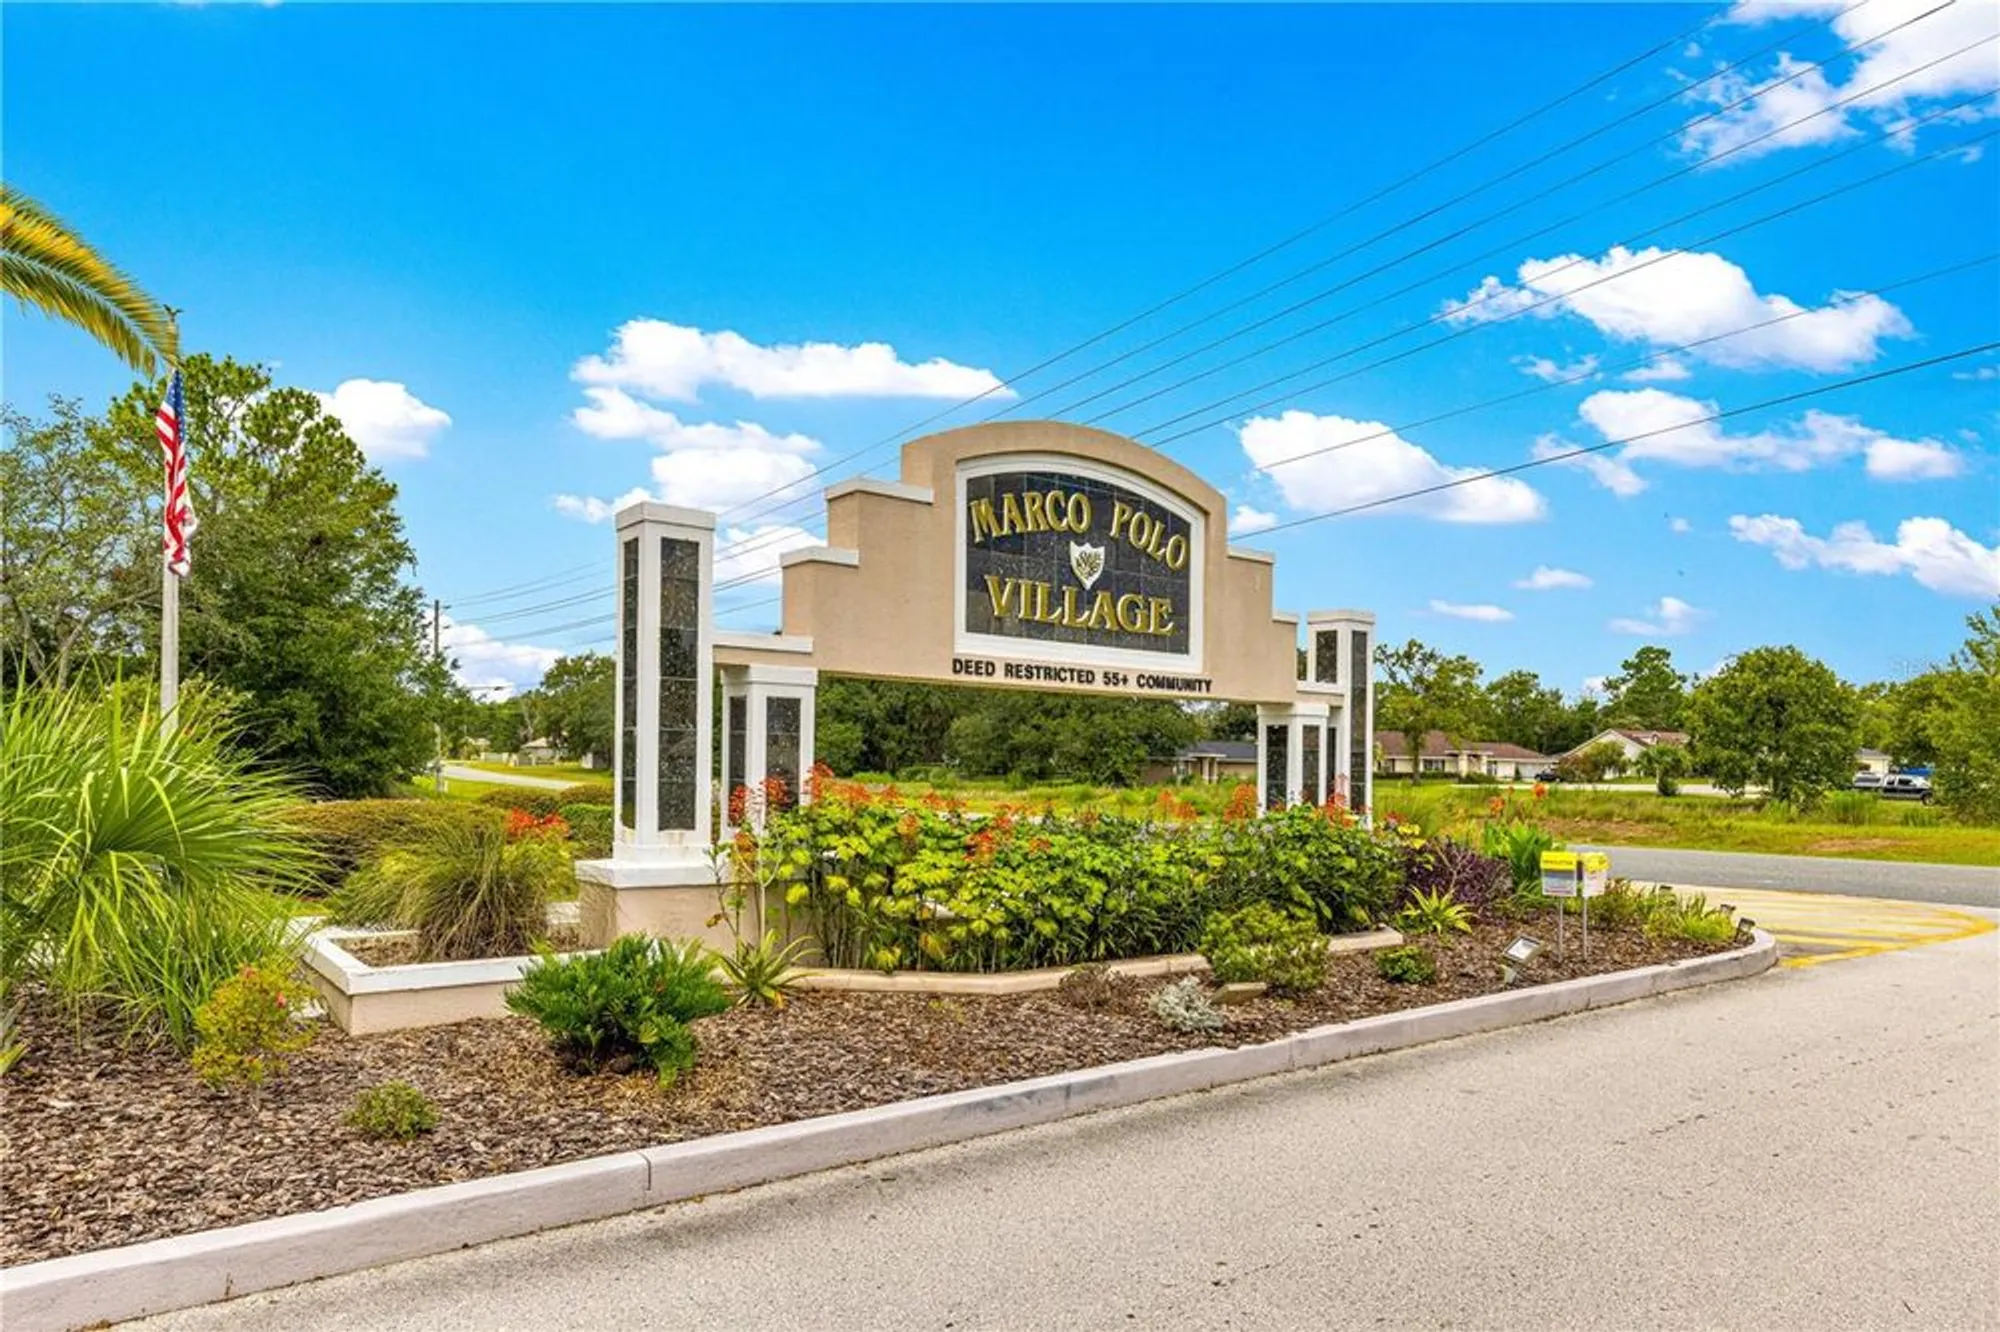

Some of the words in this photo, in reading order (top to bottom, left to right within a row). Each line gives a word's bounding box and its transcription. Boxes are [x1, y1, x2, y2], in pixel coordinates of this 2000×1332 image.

[970, 490, 1092, 543] MARCO
[1109, 499, 1188, 571] POLO
[984, 574, 1175, 636] VILLAGE
[952, 658, 996, 677] DEED
[1004, 663, 1096, 684] RESTRICTED
[1103, 671, 1129, 686] 55+
[1136, 674, 1213, 693] COMMUNITY
